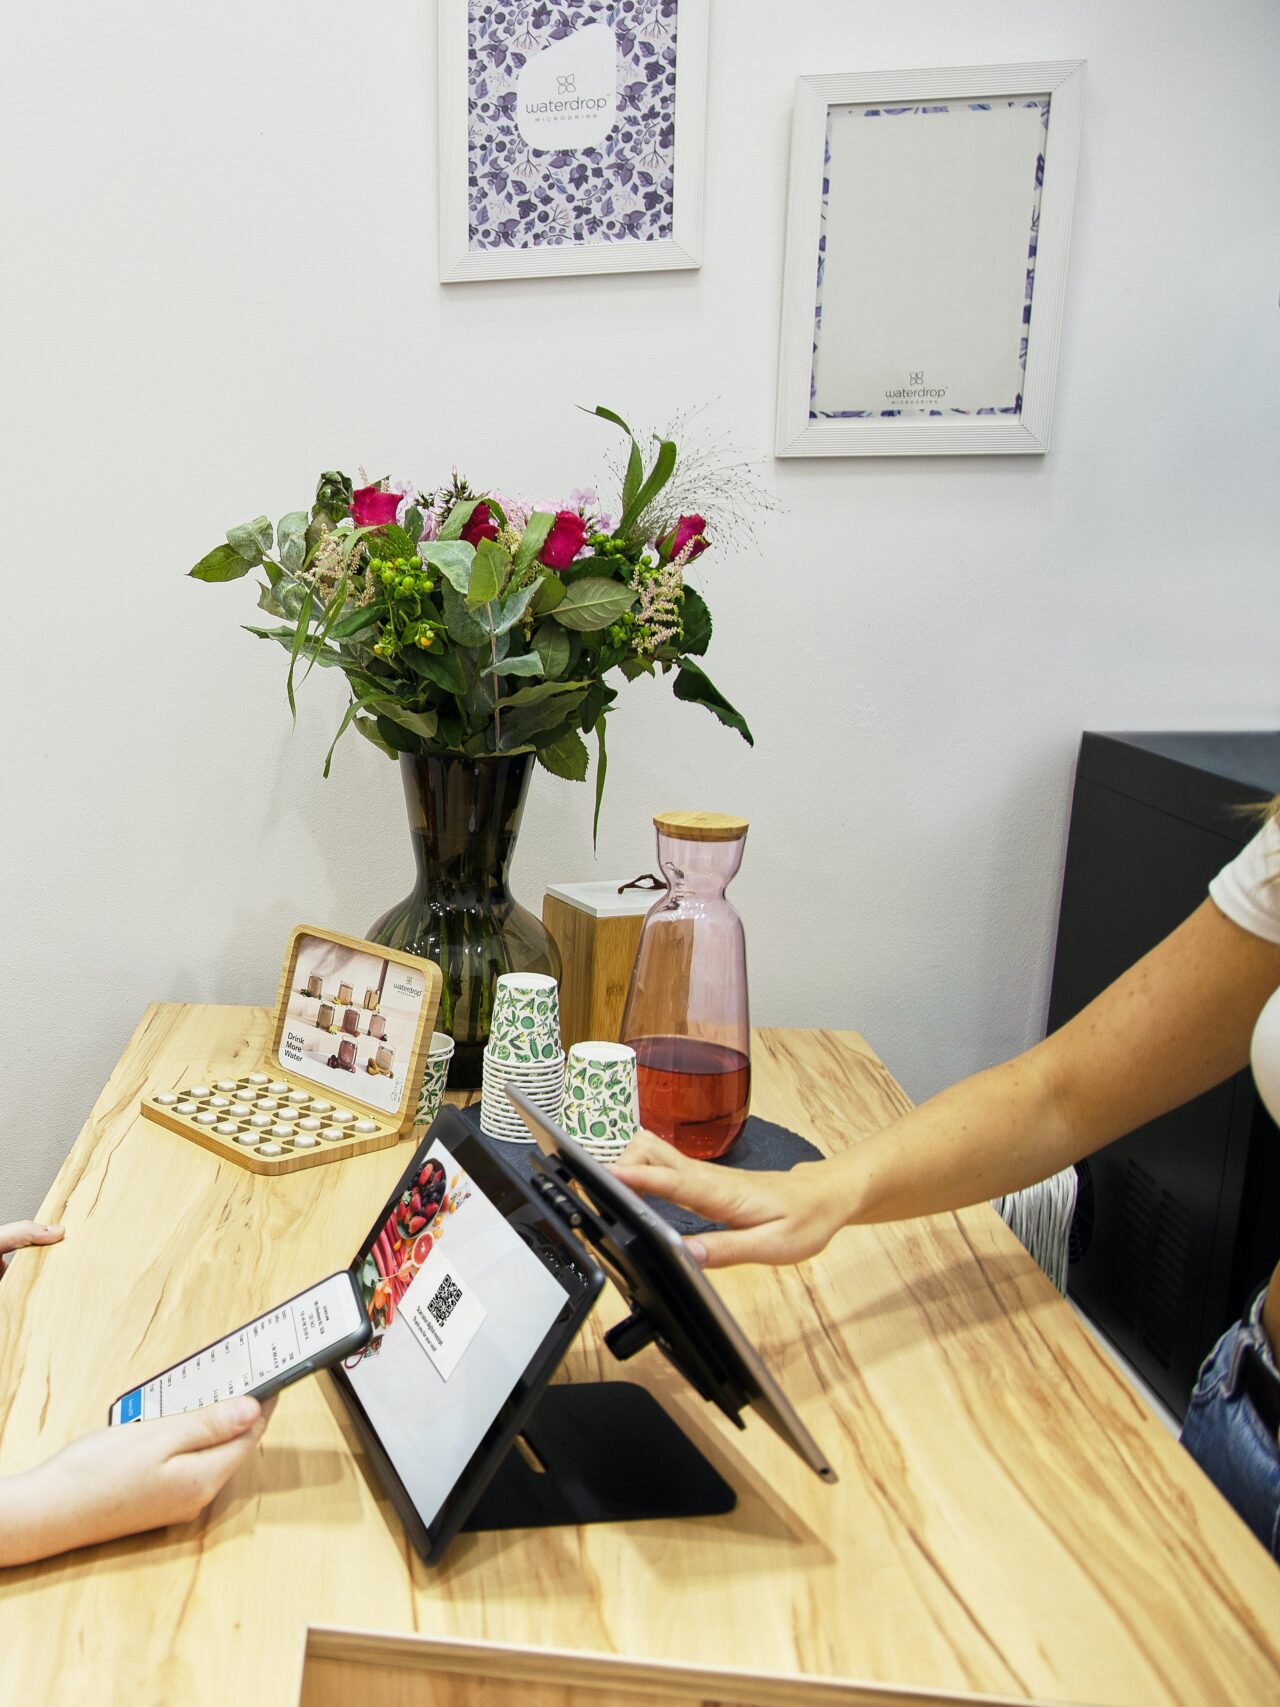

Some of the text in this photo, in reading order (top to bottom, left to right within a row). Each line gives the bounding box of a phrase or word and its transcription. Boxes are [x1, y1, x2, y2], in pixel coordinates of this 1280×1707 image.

[525, 96, 607, 114] waterdrop
[885, 387, 946, 399] waterdrop
[287, 1032, 305, 1044] Drink
[285, 1041, 302, 1052] More
[284, 1049, 303, 1062] Water
